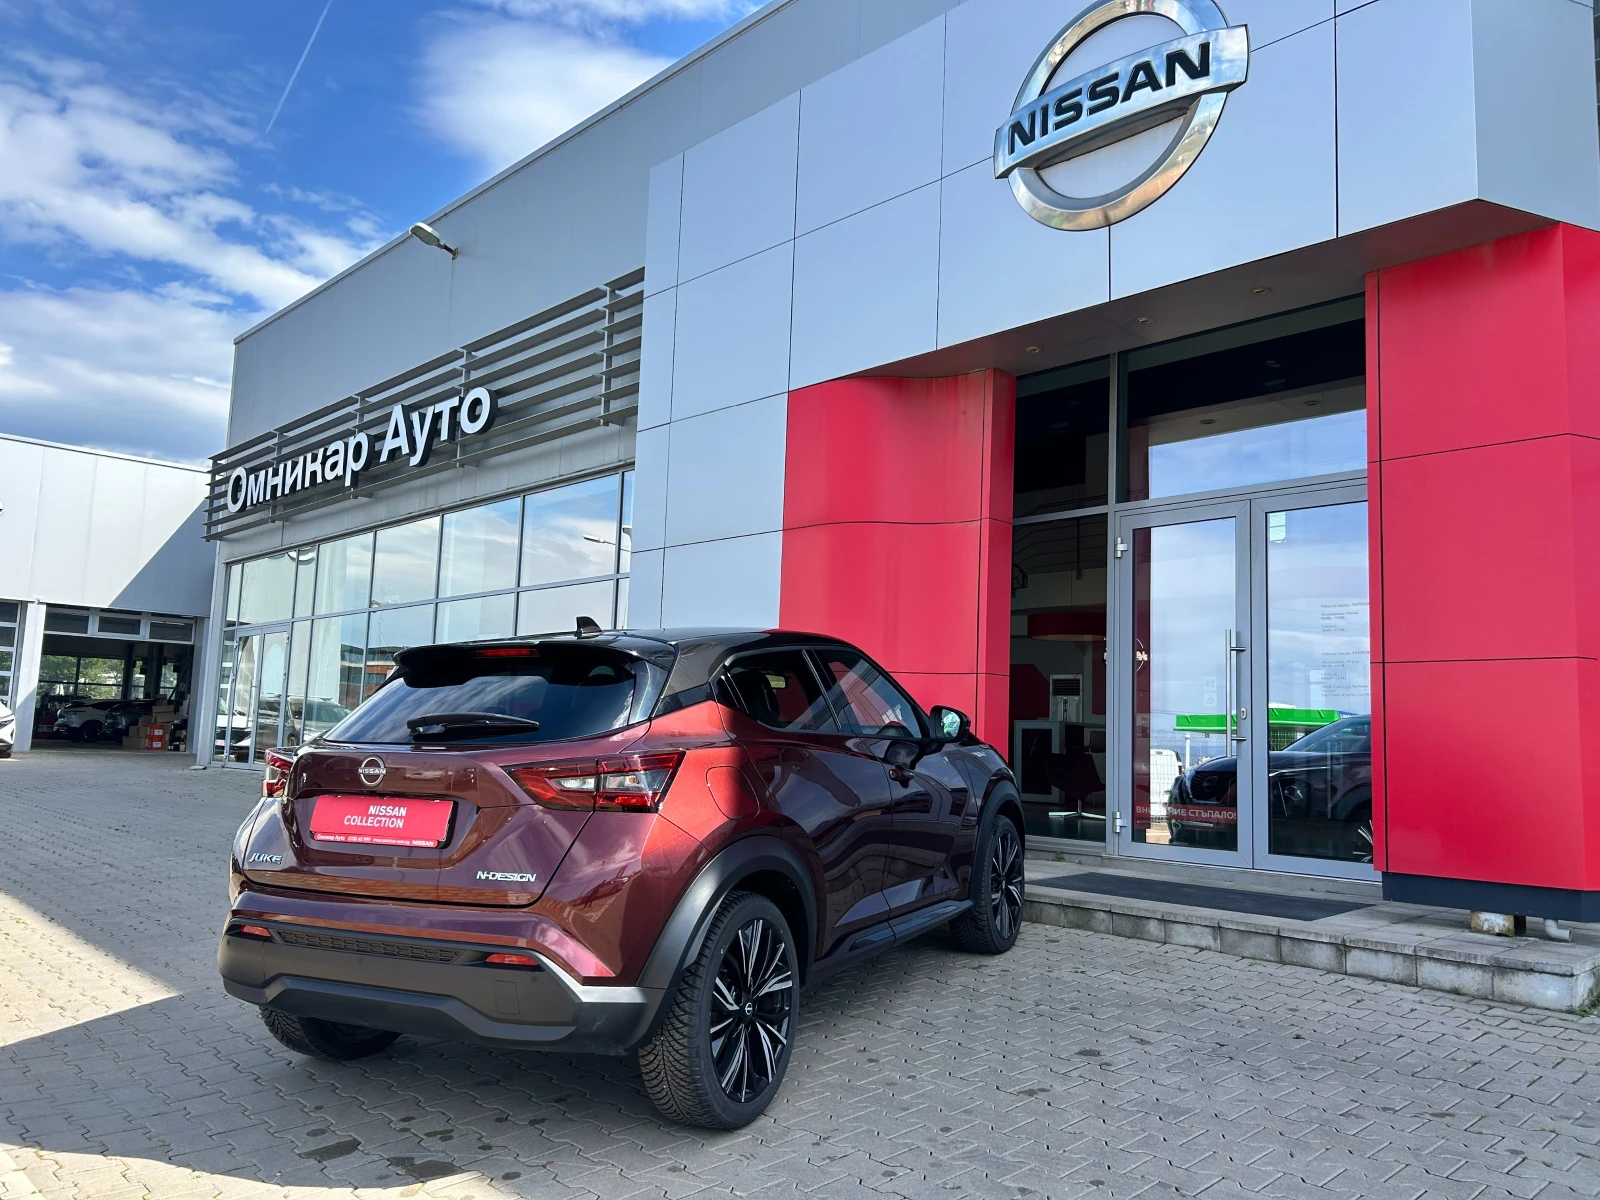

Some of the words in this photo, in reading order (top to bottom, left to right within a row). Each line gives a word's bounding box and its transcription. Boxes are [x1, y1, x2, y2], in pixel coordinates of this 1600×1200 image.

[1008, 41, 1211, 156] NISSAN
[226, 431, 370, 514] Омникар
[379, 386, 492, 467] Ауто
[368, 805, 407, 817] NISSAN
[1188, 809, 1237, 820] СТЪПАЛО!
[343, 815, 405, 829] COLLECTION
[248, 852, 283, 864] JUKE
[476, 870, 537, 882] N-DESIGN
